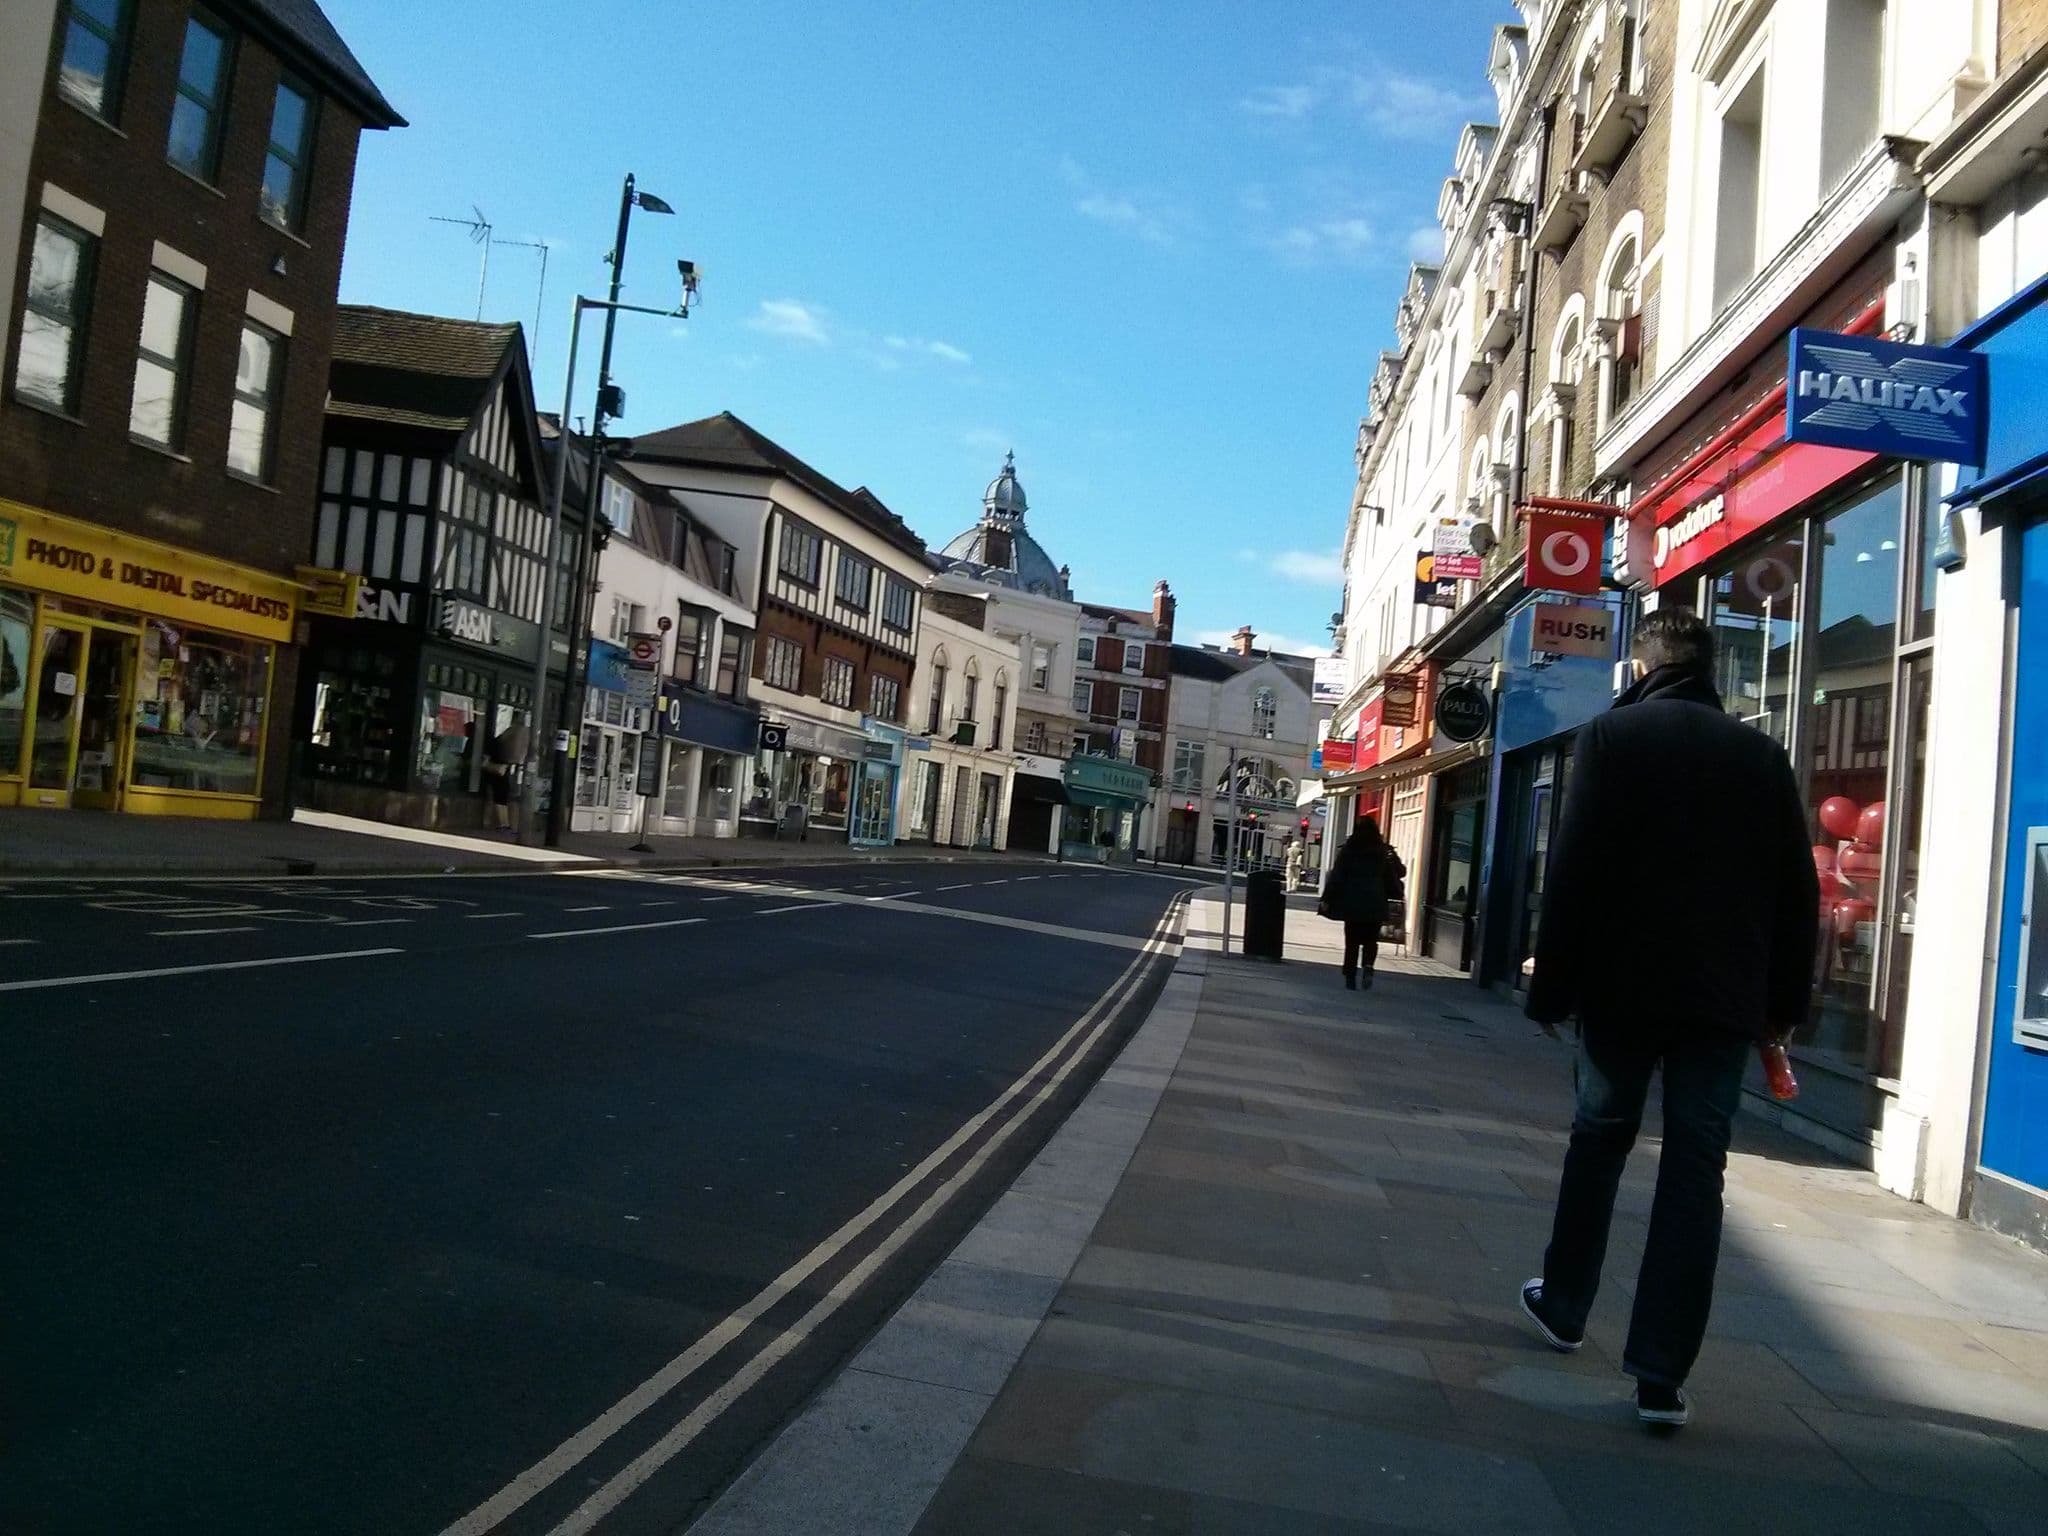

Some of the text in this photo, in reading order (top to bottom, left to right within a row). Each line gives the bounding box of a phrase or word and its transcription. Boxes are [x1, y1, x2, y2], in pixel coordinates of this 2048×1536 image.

[1799, 370, 1968, 418] HALIFAX
[1668, 493, 1725, 551] vodafone
[27, 538, 95, 574] PHOTO
[100, 558, 113, 579] &
[120, 562, 187, 597] DIGITAL
[190, 580, 289, 622] SPECIALISTS
[357, 586, 411, 624] &N
[454, 606, 492, 644] A&N
[1541, 619, 1607, 642] RUSH
